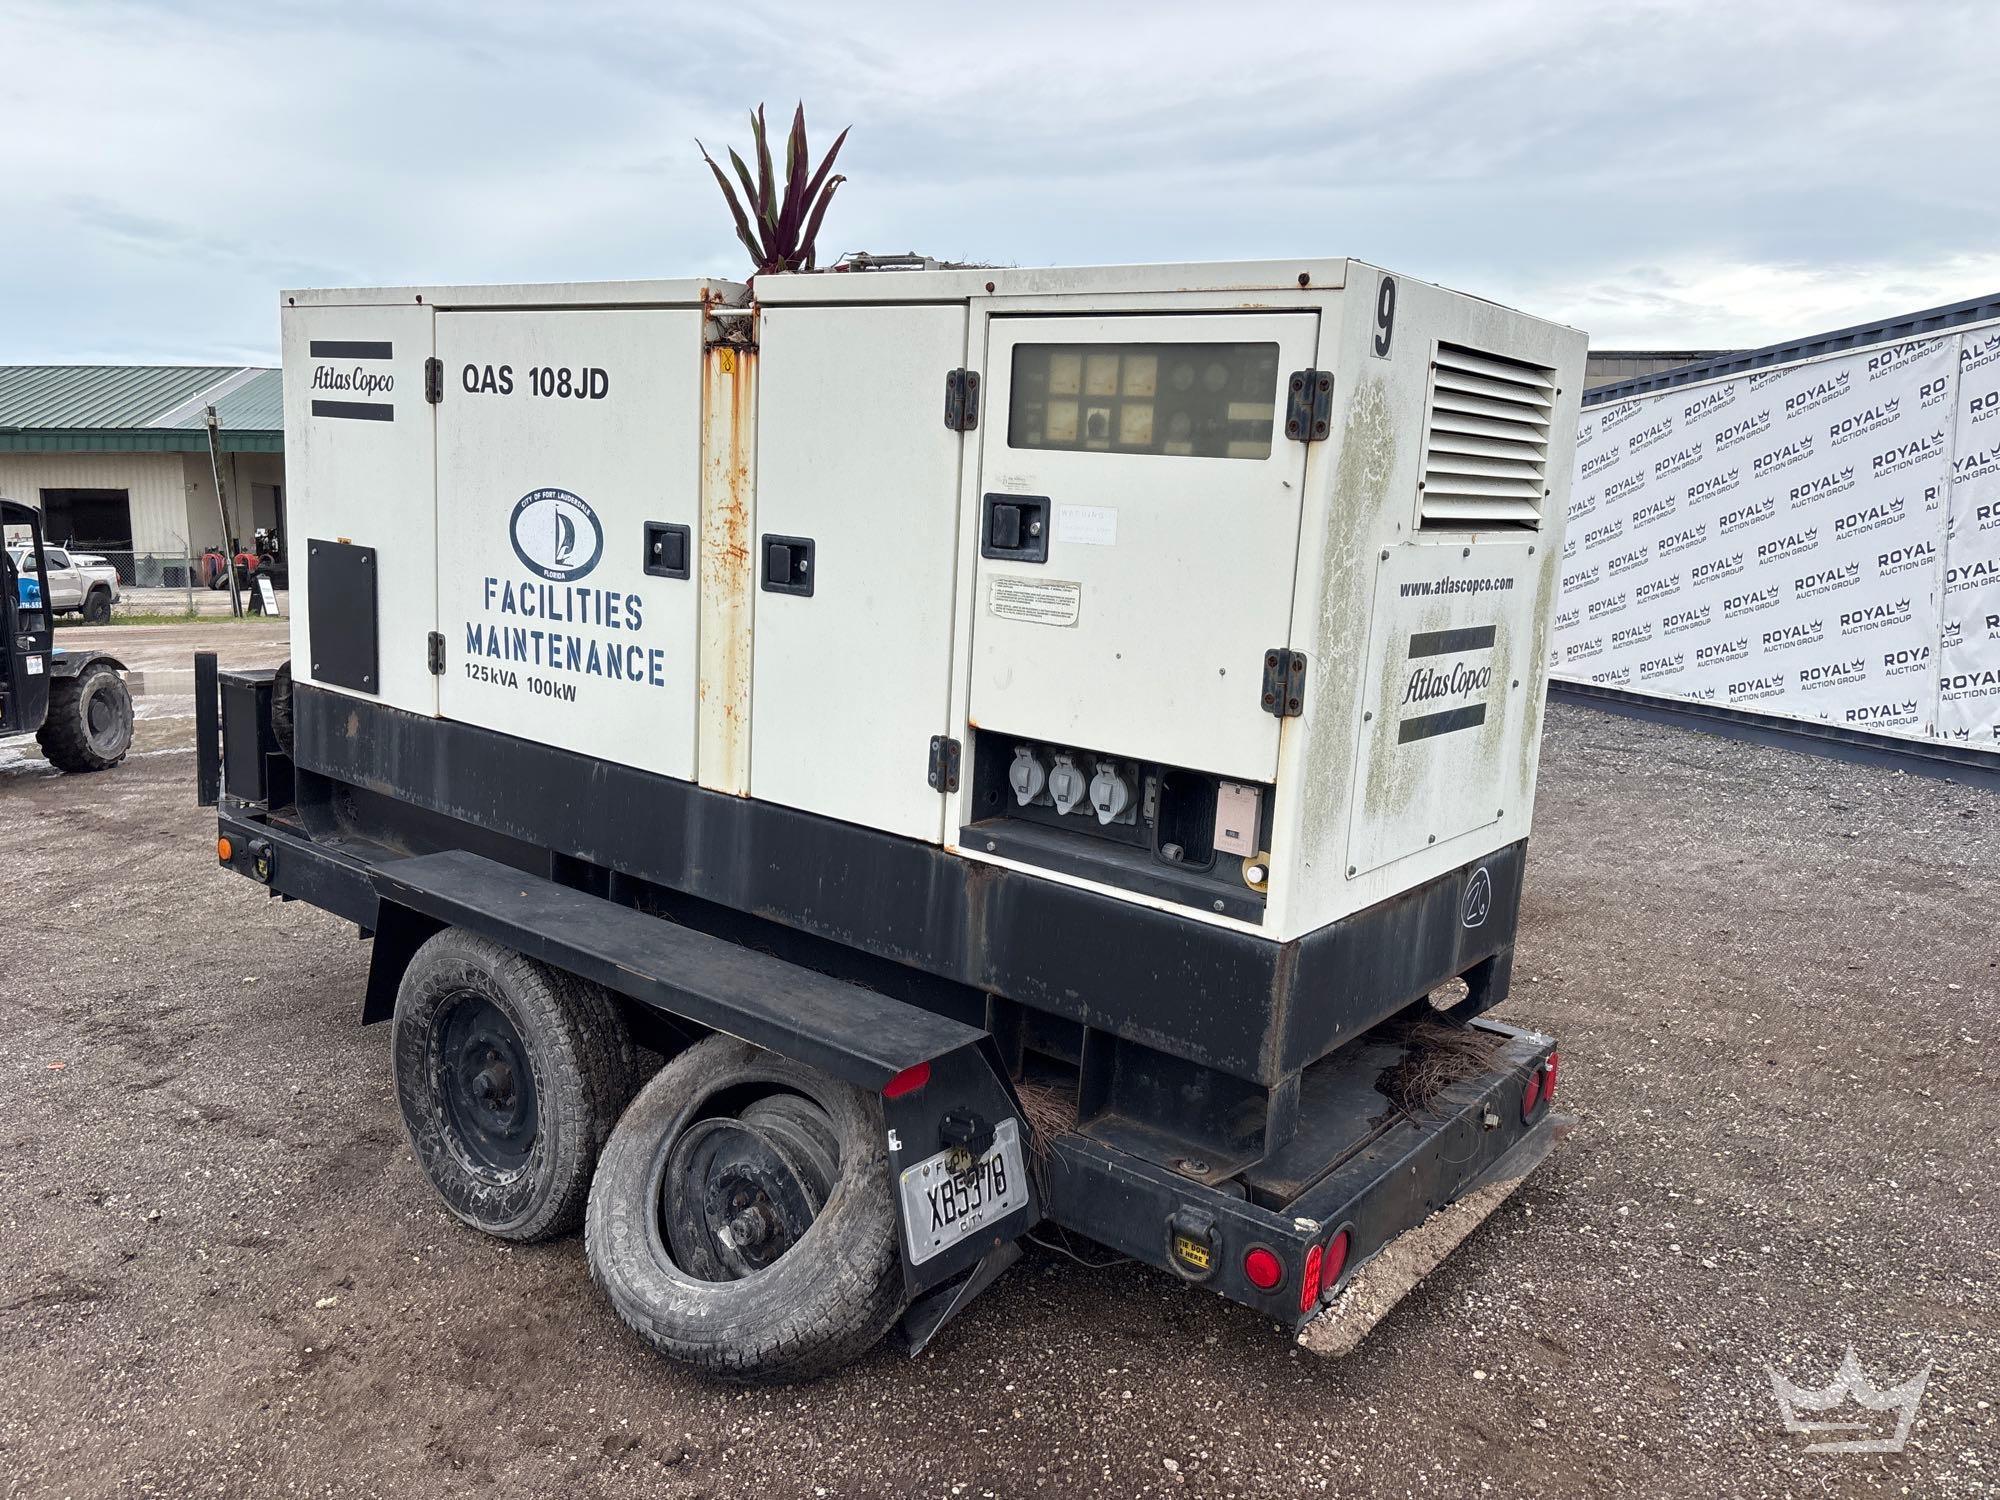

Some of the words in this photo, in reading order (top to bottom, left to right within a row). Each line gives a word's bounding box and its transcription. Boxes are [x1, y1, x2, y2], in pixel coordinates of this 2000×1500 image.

[1375, 276, 1395, 357] 9
[1869, 357, 1909, 382] AUCTION
[1910, 342, 1944, 362] GROUP
[462, 364, 513, 394] QAS
[529, 367, 609, 399] 108JD
[1750, 371, 1781, 392] AUCTION
[1685, 391, 1723, 418] ROYAL
[1786, 380, 1834, 410] ROYAL
[1787, 399, 1820, 420] AUCTION
[1822, 384, 1850, 403] GROUP
[1686, 408, 1712, 426] AUCTION
[1713, 395, 1735, 412] GROUP
[1602, 417, 1623, 434] AUCTION
[1716, 417, 1757, 443] ROYAL
[1830, 406, 1883, 437] ROYAL
[1831, 426, 1867, 448] AUCTION
[1869, 412, 1901, 431] GROUP
[1629, 423, 1662, 447] ROYAL
[1630, 439, 1652, 455] AUCTION
[1654, 428, 1673, 443] GROUP
[1716, 434, 1745, 453] AUCTION
[1746, 422, 1770, 438] GROUP
[1582, 451, 1610, 473] ROYAL
[1655, 448, 1691, 472] ROYAL
[1754, 442, 1799, 469] ROYAL
[1755, 460, 1785, 479] AUCTION
[1787, 448, 1813, 465] GROUP
[1872, 438, 1931, 468] ROYAL
[1873, 458, 1912, 479] AUCTION
[1915, 448, 1943, 464] GROU
[1953, 452, 1990, 473] YAL
[1582, 466, 1602, 480] AUCTION
[1603, 456, 1620, 469] GROUP
[1656, 464, 1680, 481] AUCTION
[1681, 454, 1702, 468] GROUP
[1604, 476, 1636, 497] ROYAL
[1605, 490, 1626, 505] AUCTION
[1627, 481, 1645, 494] GROUP
[1688, 474, 1727, 497] ROYAL
[1689, 490, 1715, 506] AUCTION
[1717, 480, 1739, 494] GROUP
[1790, 473, 1839, 500] ROYAL
[1791, 491, 1824, 510] AUCTION
[1826, 480, 1855, 496] GROUP
[1580, 505, 1596, 517] GROUP
[1632, 500, 1666, 522] ROYAL
[1633, 515, 1655, 530] AUCTION
[1657, 506, 1676, 519] GROUP
[1720, 503, 1761, 526] ROYAL
[1835, 504, 1889, 531] ROYAL
[1585, 524, 1614, 542] ROYAL
[1720, 520, 1748, 536] AUCTION
[1750, 510, 1775, 524] GROUP
[1836, 523, 1872, 541] AUCTION
[1874, 512, 1906, 528] GROUP
[1585, 537, 1605, 550] AUCTION
[1606, 530, 1623, 541] GROUP
[1659, 529, 1695, 550] ROYAL
[1659, 544, 1684, 558] AUCTION
[1685, 535, 1706, 548] GROUP
[1759, 533, 1804, 556] ROYAL
[1608, 551, 1639, 570] ROYAL
[1759, 550, 1790, 566] AUCTION
[1792, 541, 1818, 555] GROUP
[1878, 541, 1935, 567] ROYAL
[1563, 569, 1591, 586] ROYAL
[1608, 564, 1630, 577] AUCTION
[1631, 557, 1649, 569] GROUP
[1692, 557, 1731, 578] ROYAL
[1693, 572, 1719, 586] AUCTION
[1721, 565, 1744, 577] GROUP
[1878, 560, 1918, 578] AUCTION
[1947, 560, 1998, 583] OYAL
[1400, 576, 1513, 597] www.atlascopco.com
[1564, 582, 1582, 594] AUCTION
[1583, 576, 1599, 586] GROUP
[1636, 578, 1669, 597] ROYAL
[1795, 568, 1844, 590] ROYAL
[1796, 585, 1829, 600] AUCTION
[1831, 576, 1860, 590] GROUP
[484, 577, 643, 631] FACILITIES
[1588, 596, 1618, 613] ROYAL
[1636, 592, 1659, 605] AUCTION
[1660, 586, 1680, 597] GROUP
[1724, 590, 1766, 610] ROYAL
[1555, 612, 1572, 624] YAL
[1589, 609, 1609, 621] AUCTION
[1610, 604, 1627, 614] GROUP
[1663, 609, 1699, 627] ROYAL
[1725, 606, 1753, 619] AUCTION
[1755, 599, 1780, 611] GROUP
[1841, 603, 1895, 626] ROYAL
[1564, 619, 1580, 628] GROUP
[1612, 626, 1643, 642] ROYAL
[1664, 624, 1688, 636] AUCTION
[1690, 618, 1711, 628] GROUP
[1763, 624, 1809, 643] ROYAL
[1841, 621, 1878, 636] AUCTION
[1880, 614, 1912, 627] GROUP
[1567, 640, 1594, 655] ROYAL
[1612, 639, 1634, 650] AUCTION
[1635, 634, 1653, 644] GROUP
[1697, 642, 1736, 659] ROYAL
[1764, 640, 1795, 653] AUCTION
[1797, 634, 1823, 645] GROUP
[1942, 638, 1963, 648] OUP
[466, 622, 664, 687] MAINTENANCE
[1567, 652, 1586, 662] AUCTION
[1587, 648, 1603, 657] GROUP
[1640, 656, 1674, 672] ROYAL
[1697, 656, 1724, 668] AUCTION
[1726, 651, 1748, 661] GROUP
[1884, 647, 1929, 666] ROYA
[1640, 670, 1663, 680] AUCTION
[1664, 665, 1684, 675] GROUP
[1800, 662, 1850, 681] ROYAL
[1885, 663, 1926, 676] AUCTION
[527, 677, 576, 702] 100kW
[1729, 677, 1771, 694] ROYAL
[1801, 679, 1835, 691] AUCTION
[1837, 673, 1866, 684] GROUP
[1940, 670, 2000, 691] ROYA
[1730, 692, 1758, 703] AUCTION
[1760, 688, 1785, 698] GROUP
[1942, 688, 1987, 701] AUCTION
[1846, 703, 1901, 720] ROYAL
[1887, 715, 1919, 726] GROUP
[960, 1210, 984, 1232] CITY
